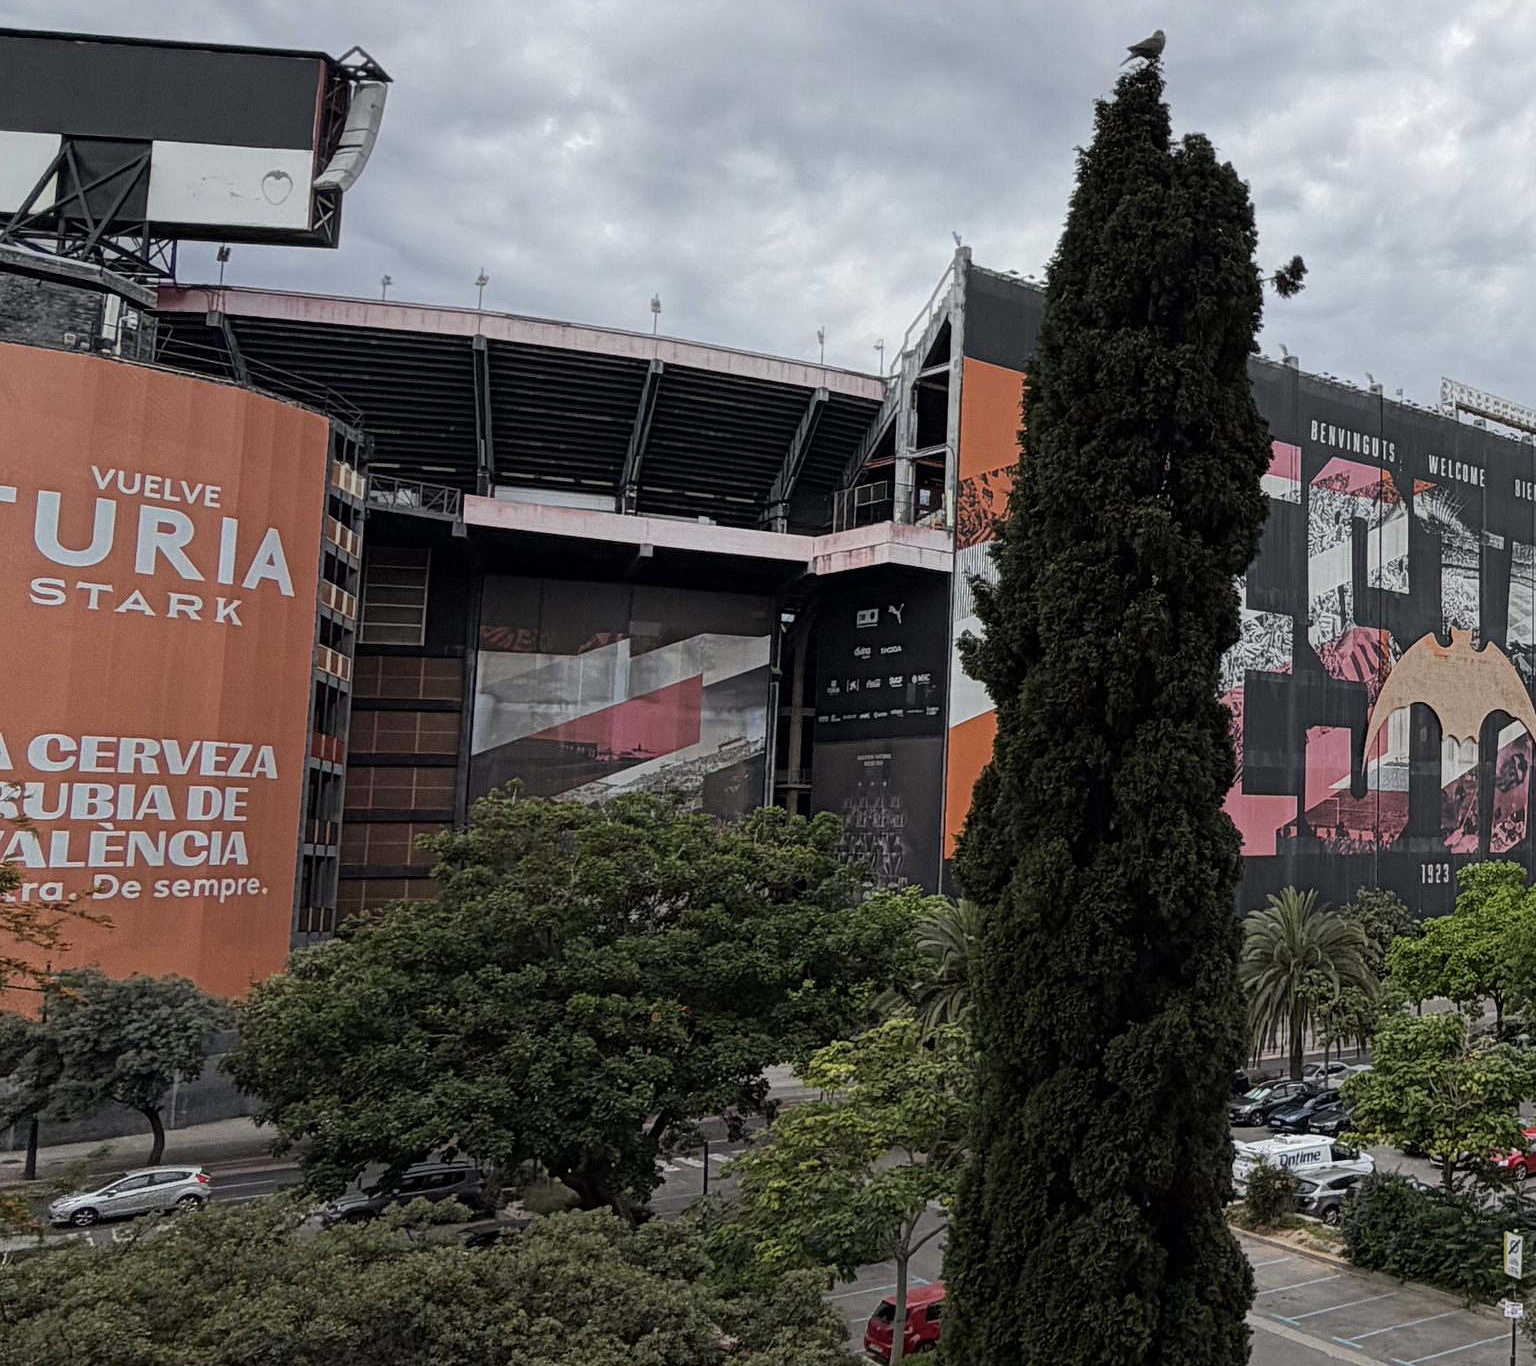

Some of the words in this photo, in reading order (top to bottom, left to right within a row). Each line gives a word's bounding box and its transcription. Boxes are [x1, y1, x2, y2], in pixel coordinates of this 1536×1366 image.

[1310, 420, 1395, 463] BENVINGUTS
[91, 465, 222, 508] VUELVE
[1428, 454, 1485, 487] WELCOME
[29, 577, 242, 626] STARK
[28, 734, 278, 779] CERVEZA
[187, 786, 249, 822] DE
[0, 822, 248, 868] ALÈNCIA
[92, 874, 142, 900] De
[153, 878, 268, 904] sempre.
[1420, 863, 1450, 884] 1923
